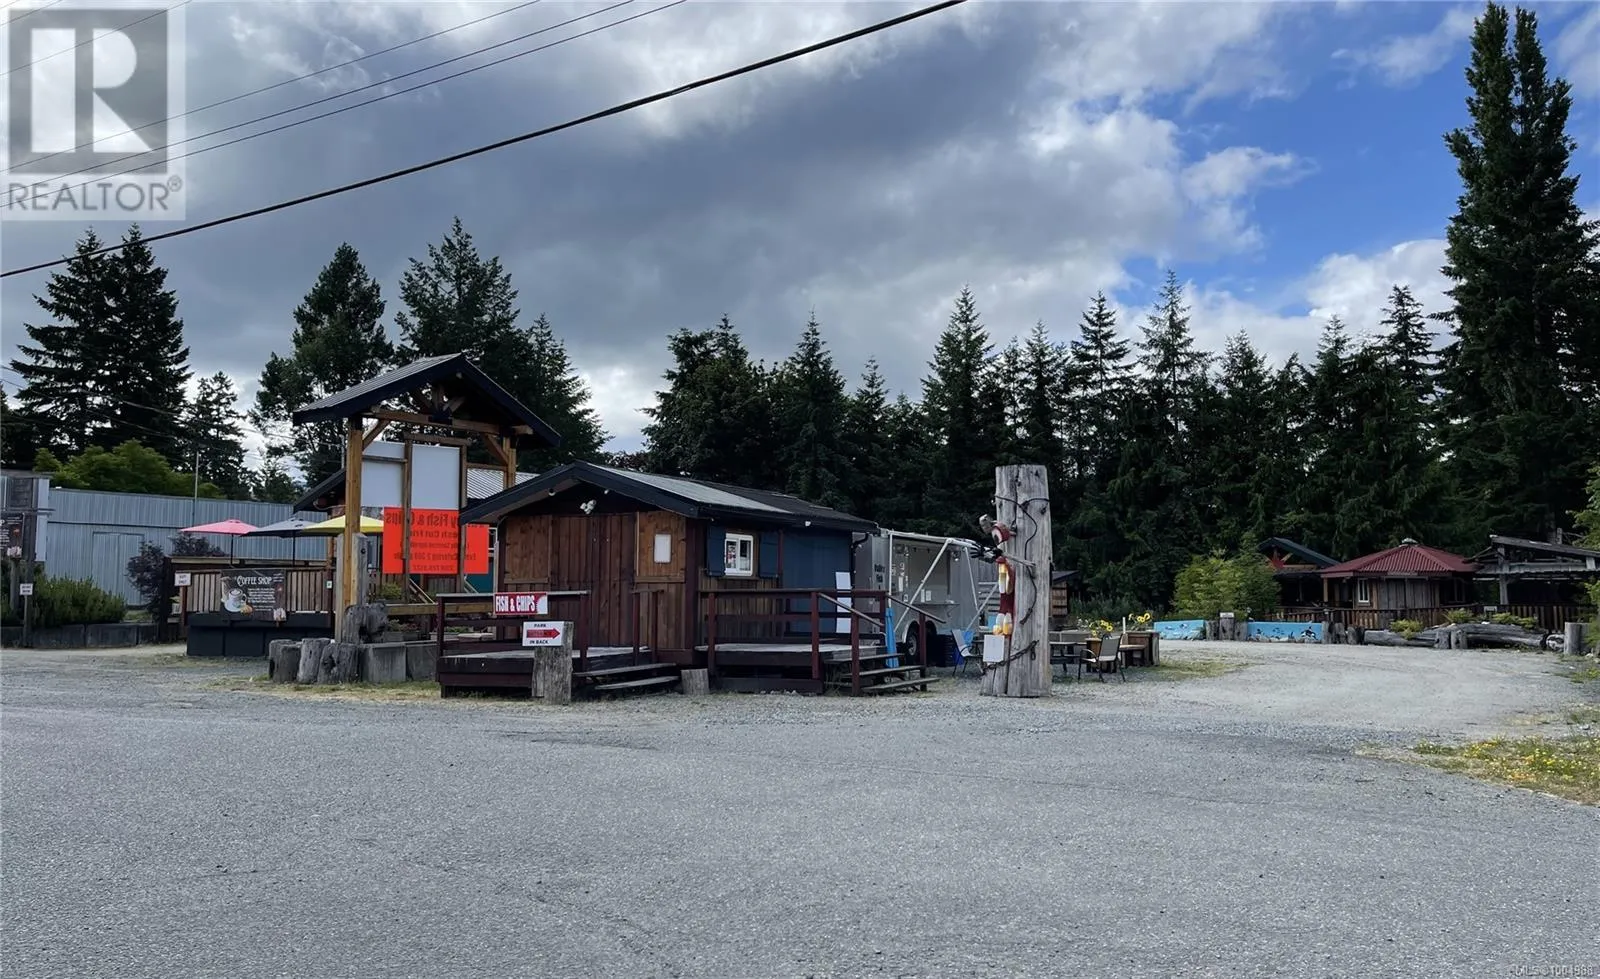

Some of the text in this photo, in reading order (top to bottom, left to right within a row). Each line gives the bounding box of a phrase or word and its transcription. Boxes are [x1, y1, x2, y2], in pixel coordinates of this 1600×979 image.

[257, 576, 273, 585] SHOP
[495, 595, 535, 612] FISH & CHIPS
